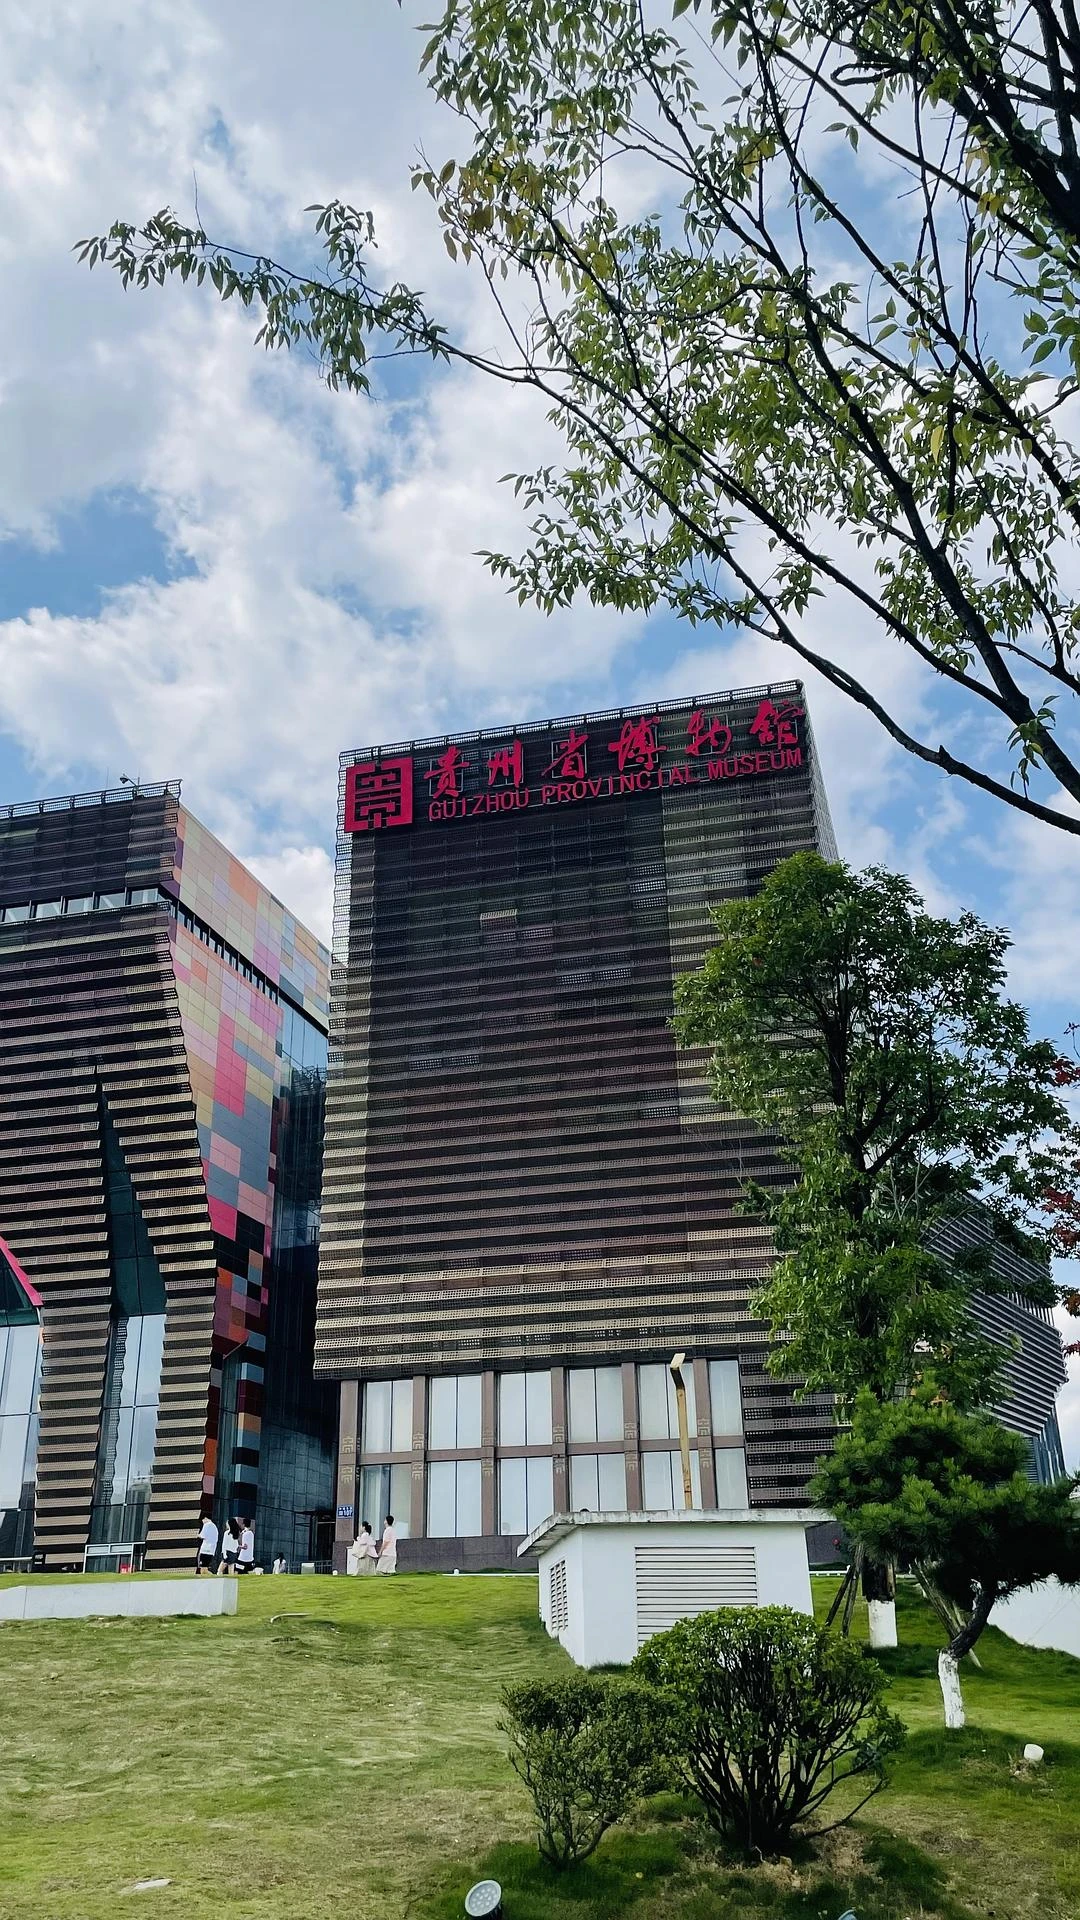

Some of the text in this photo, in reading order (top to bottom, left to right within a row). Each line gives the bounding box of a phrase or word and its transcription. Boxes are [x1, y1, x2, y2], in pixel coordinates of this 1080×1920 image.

[428, 747, 802, 820] GUIZHOU PROVINCIAL MUSEUM
